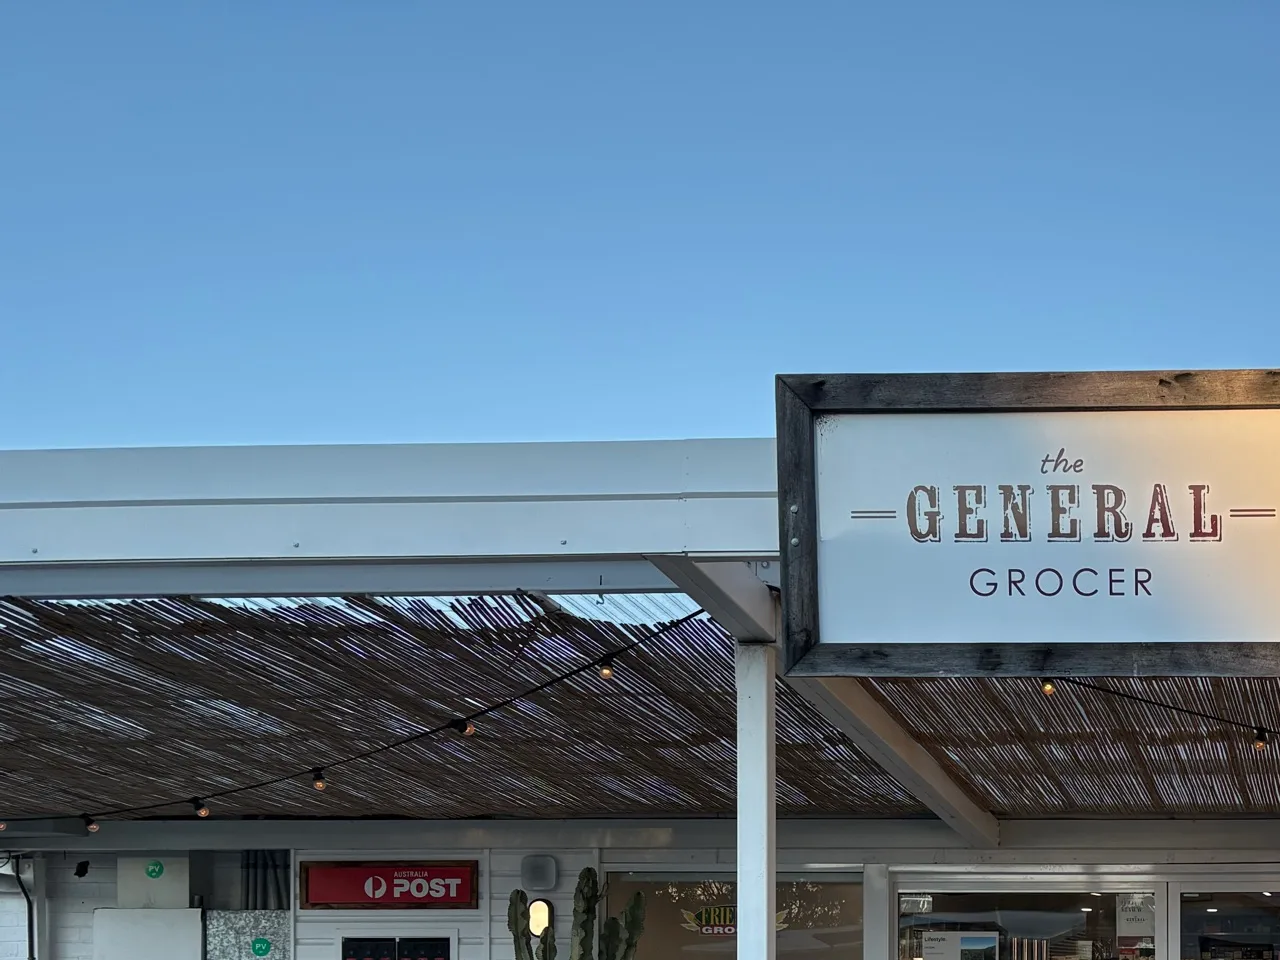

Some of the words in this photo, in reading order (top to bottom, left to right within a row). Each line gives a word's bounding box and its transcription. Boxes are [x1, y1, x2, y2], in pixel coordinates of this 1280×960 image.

[1040, 447, 1085, 475] the
[906, 483, 1224, 543] GENERAL
[969, 567, 1153, 597] GROCER
[394, 878, 462, 898] POST
[701, 906, 734, 925] FRIE
[702, 926, 736, 934] GRO
